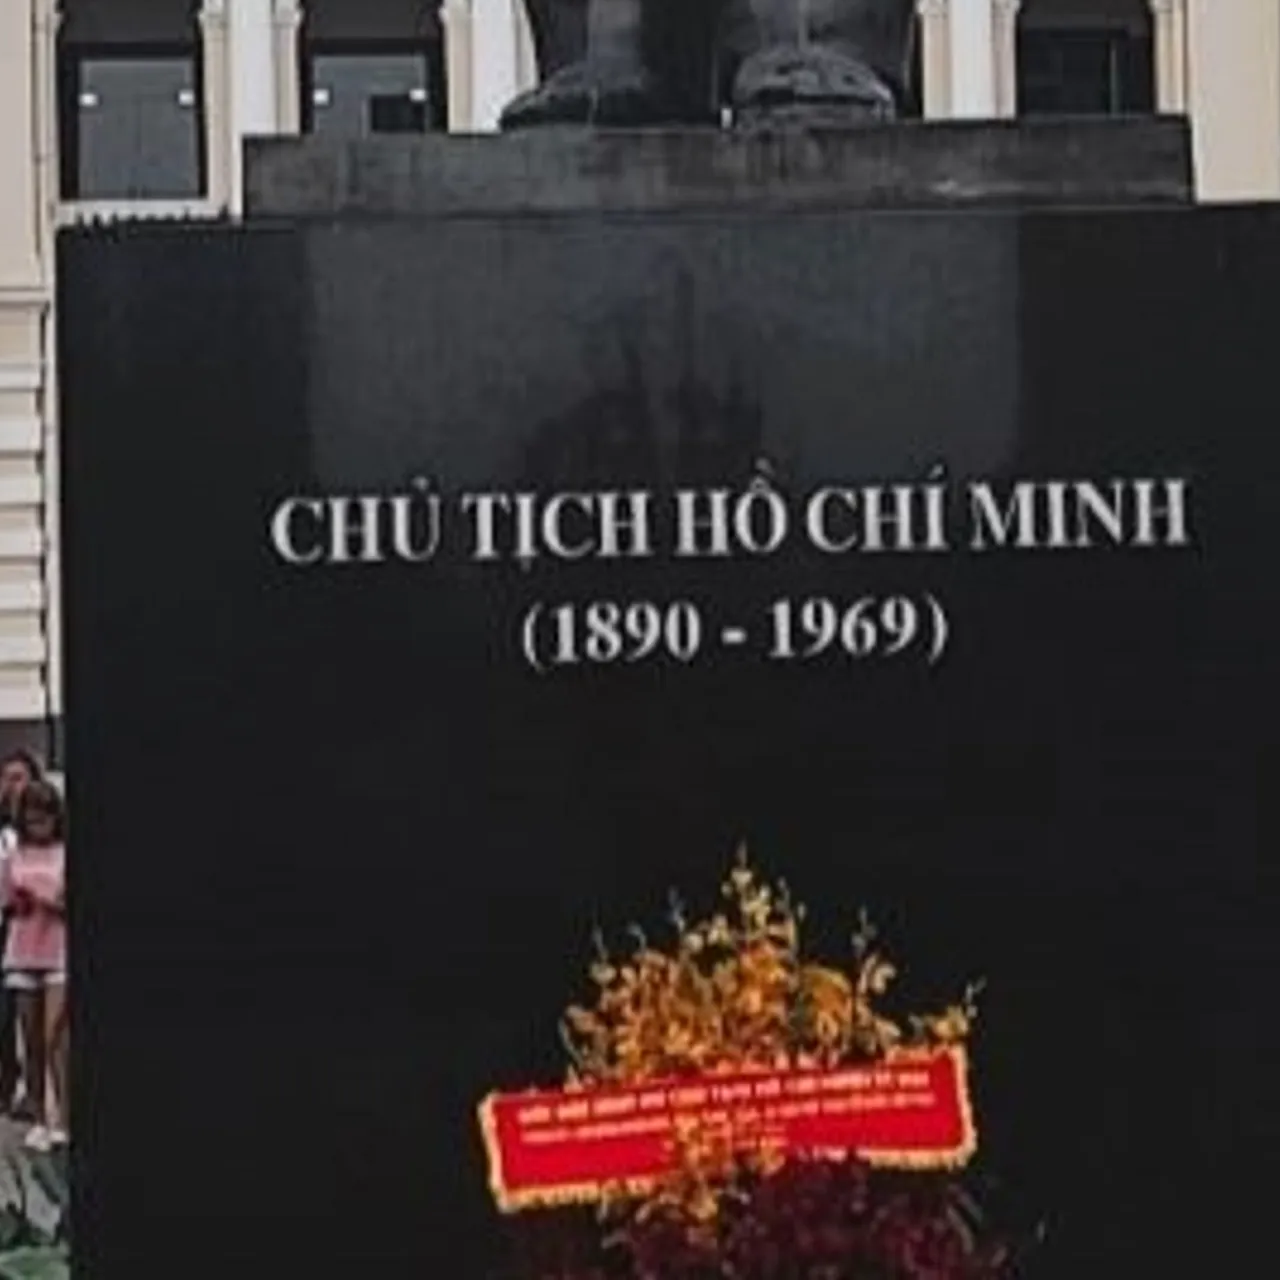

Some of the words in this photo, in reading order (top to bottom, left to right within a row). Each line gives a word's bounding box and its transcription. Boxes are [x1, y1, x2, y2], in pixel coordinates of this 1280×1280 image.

[270, 476, 442, 564] CHỦ
[461, 490, 652, 572] TỊCH
[675, 458, 789, 557] HỒ
[805, 464, 947, 553] CHÍ
[968, 477, 1188, 551] MINH
[522, 601, 702, 672] (1890
[720, 627, 748, 645] -
[769, 595, 949, 662] 1969)
